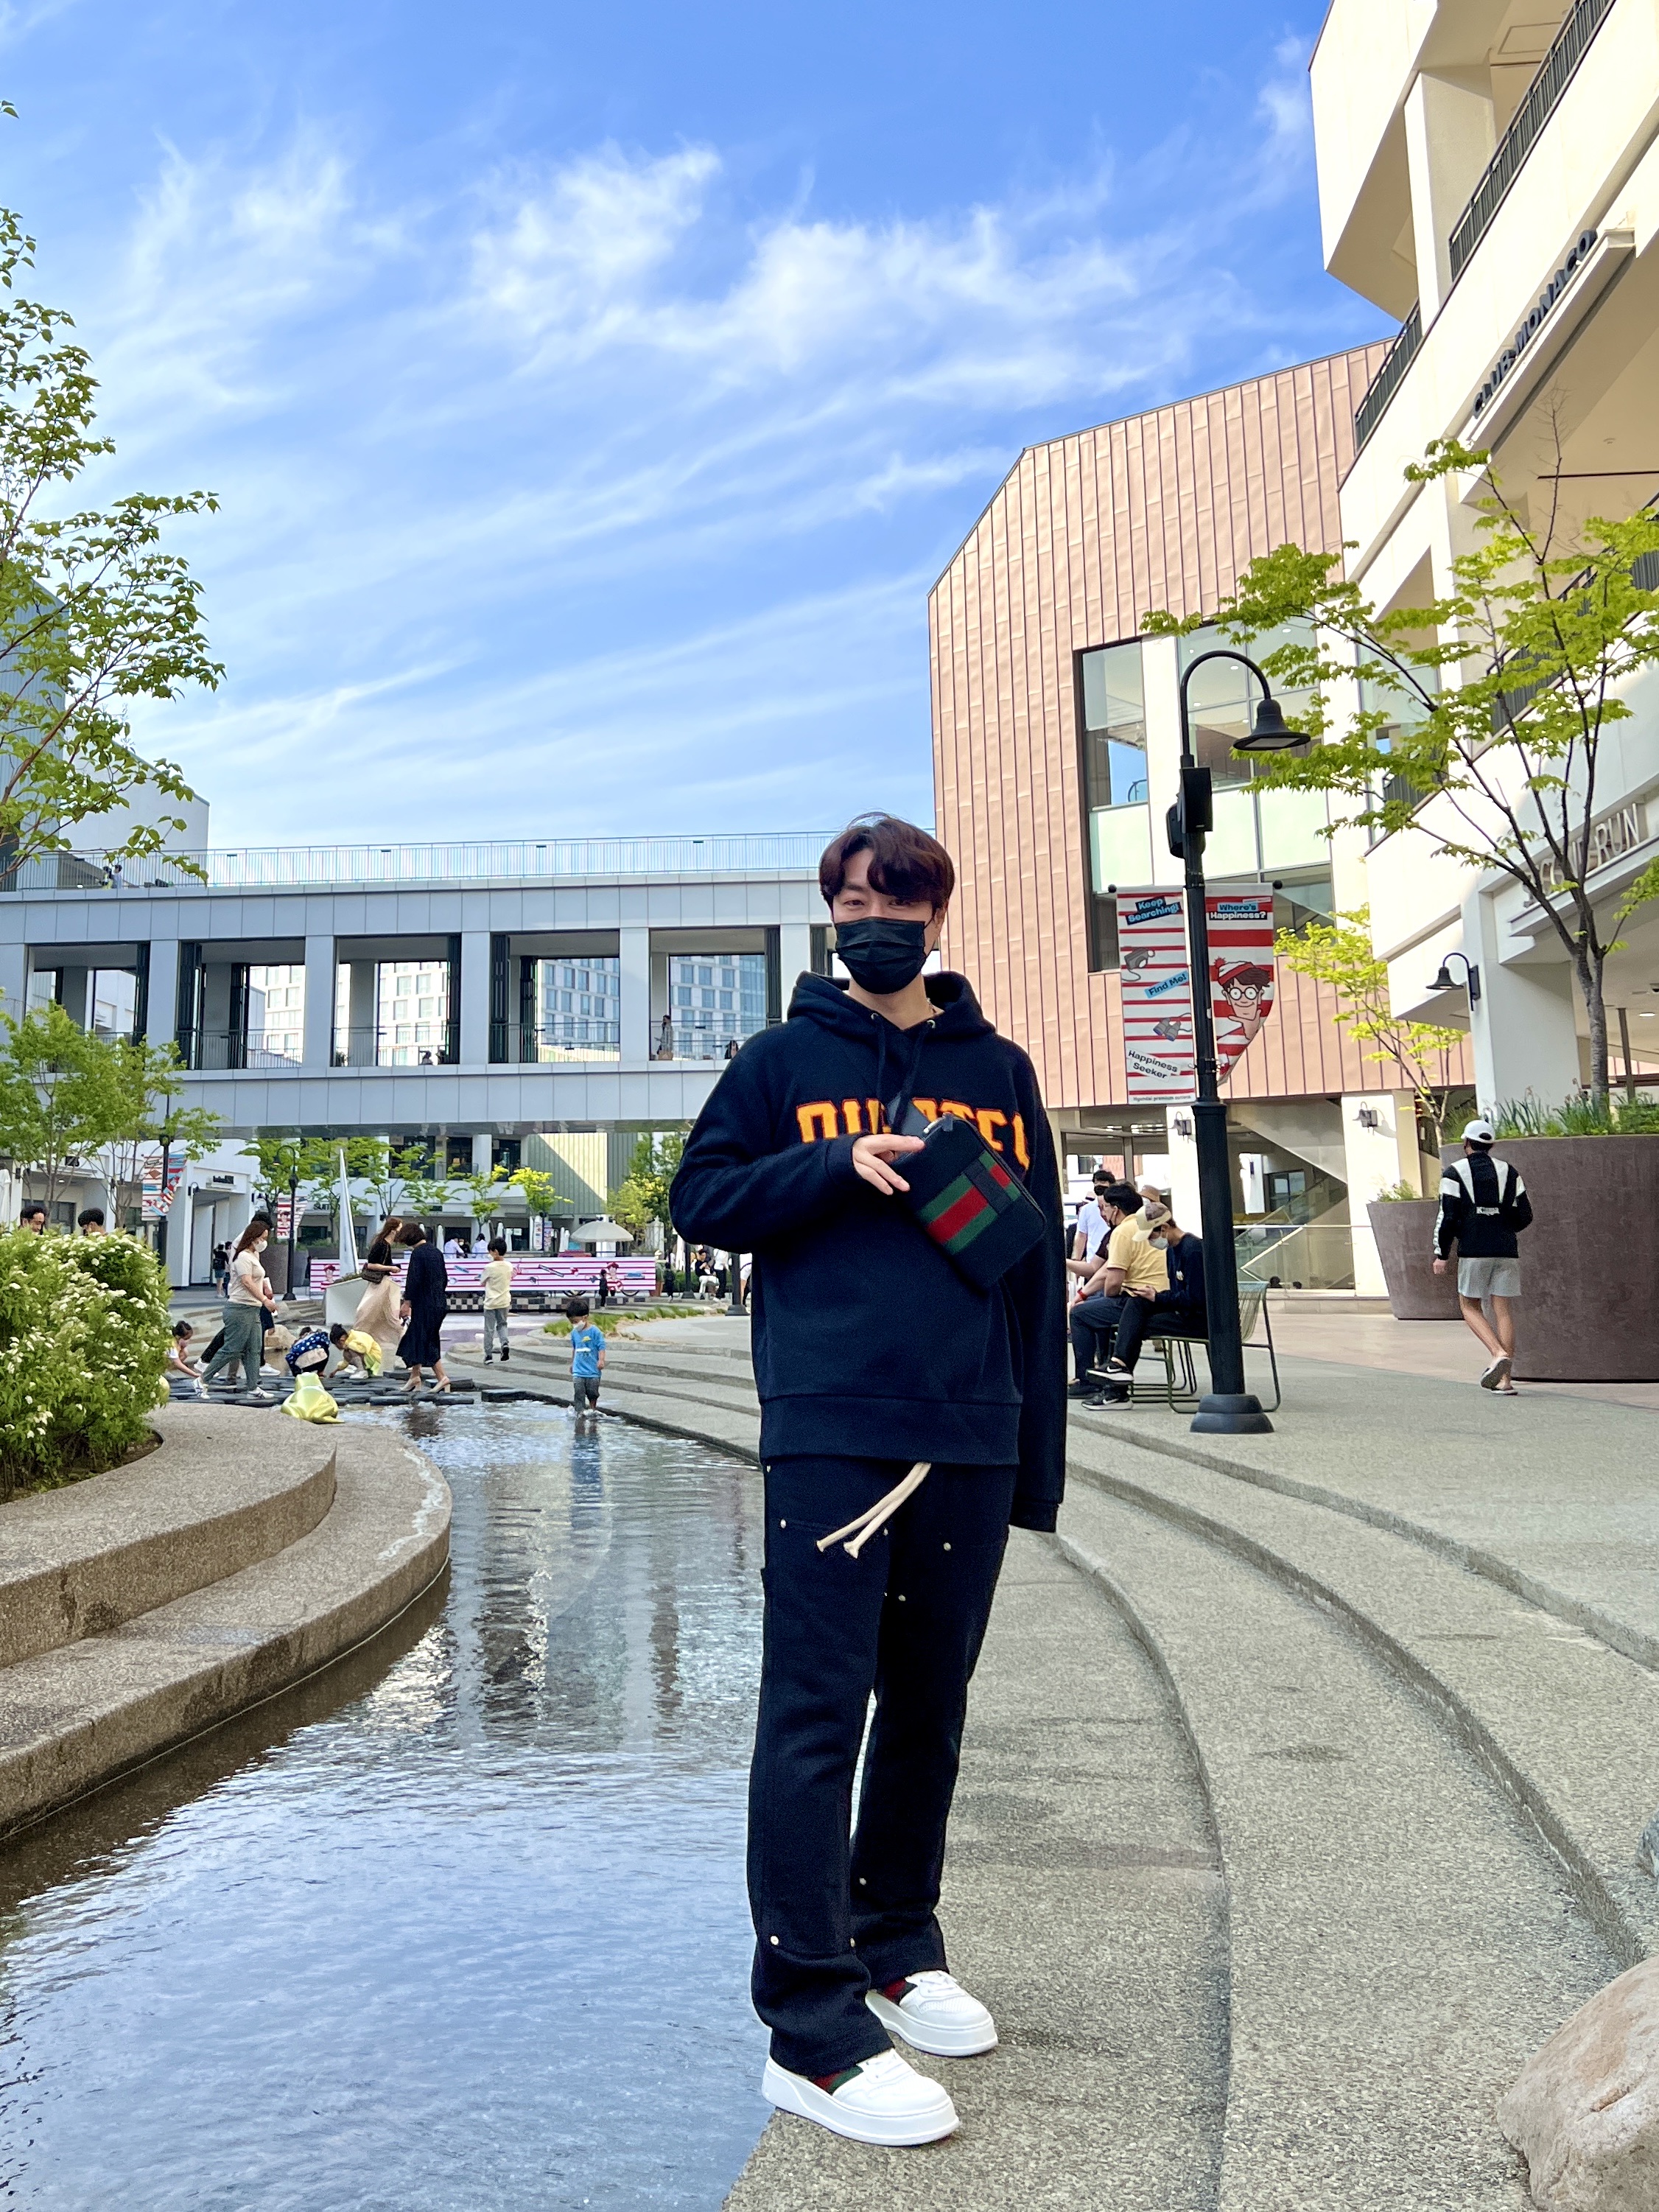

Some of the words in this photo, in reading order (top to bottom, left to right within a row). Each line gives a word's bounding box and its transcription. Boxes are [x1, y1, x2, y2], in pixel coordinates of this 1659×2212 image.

[1473, 349, 1516, 419] CLUB
[1515, 228, 1598, 355] MONACO
[1128, 903, 1179, 923] Searching!
[1137, 898, 1163, 910] Keep
[1210, 911, 1266, 920] Happiness?
[1148, 981, 1168, 995] Find
[1168, 973, 1187, 986] Me!
[1128, 1049, 1178, 1073] Happiness
[1132, 1062, 1168, 1079] Seeker
